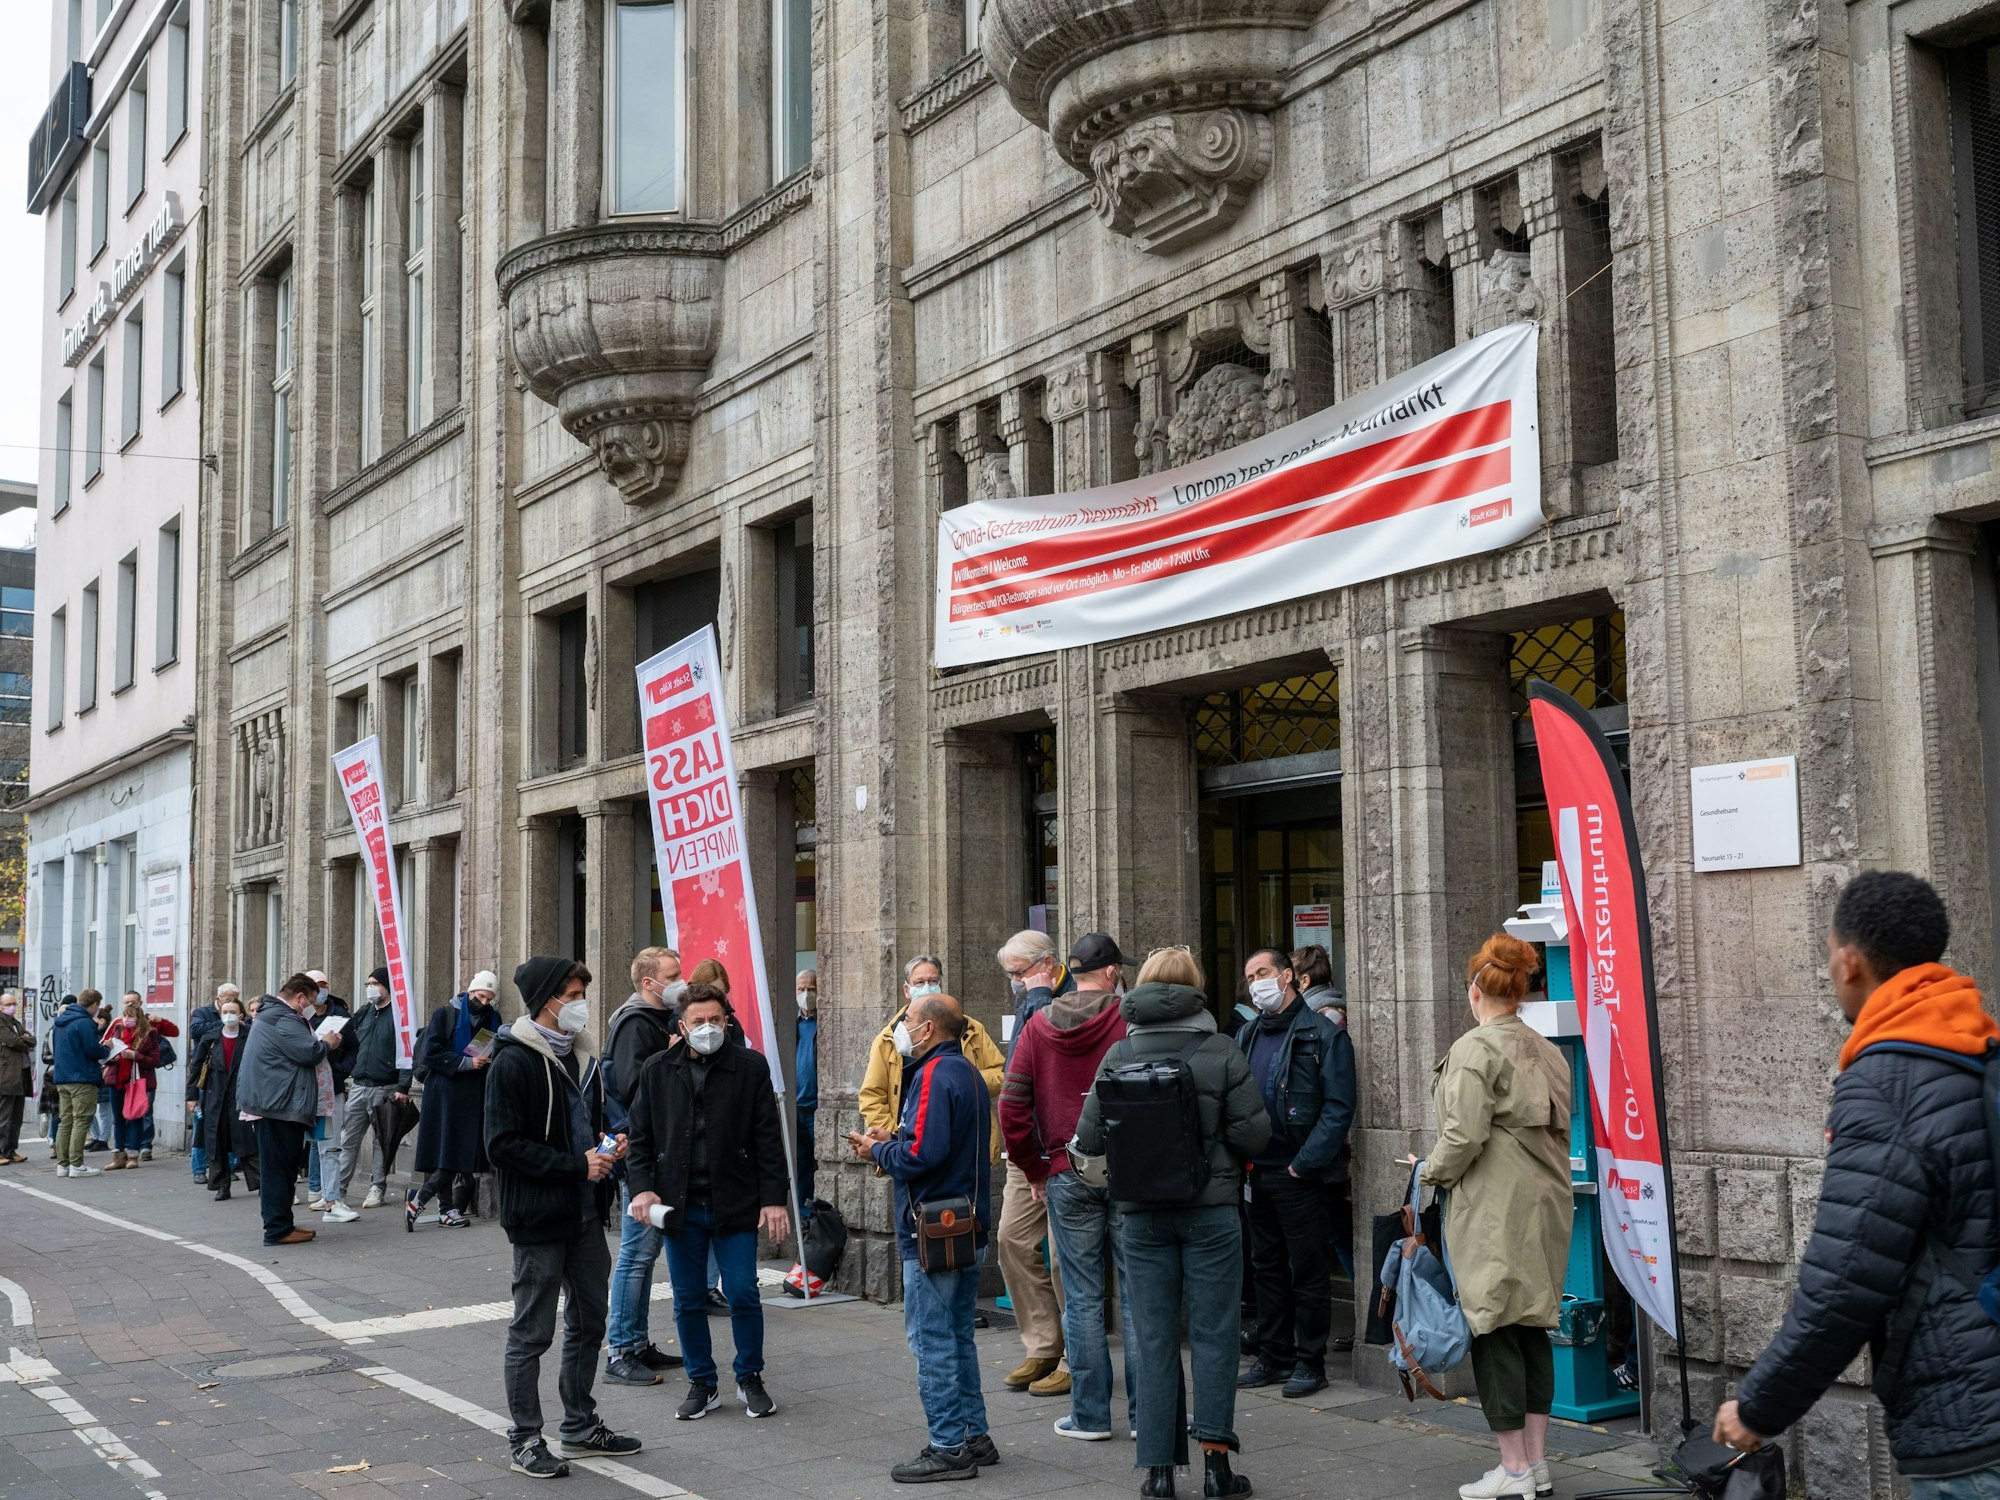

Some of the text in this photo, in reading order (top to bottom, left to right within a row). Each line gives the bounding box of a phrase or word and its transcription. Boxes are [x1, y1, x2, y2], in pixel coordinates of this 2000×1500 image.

[62, 307, 91, 366] Immer
[111, 232, 147, 302] Immer
[951, 513, 1078, 551] Corona-Testzentrum
[1079, 496, 1159, 525] Neumarkt
[1470, 507, 1499, 523] Stadt Köln
[951, 601, 986, 616] Bürgertests
[986, 595, 998, 609] und
[1037, 583, 1053, 597] sind
[1052, 583, 1065, 594] vor
[1066, 579, 1079, 591] Ort
[1079, 571, 1110, 591] möglich.
[1193, 546, 1211, 561] Uhr
[953, 566, 989, 583] Willkommen
[993, 555, 1029, 573] Welcome
[1699, 807, 1739, 817] Gesundheitsamt
[1701, 854, 1726, 862] Neumarkt
